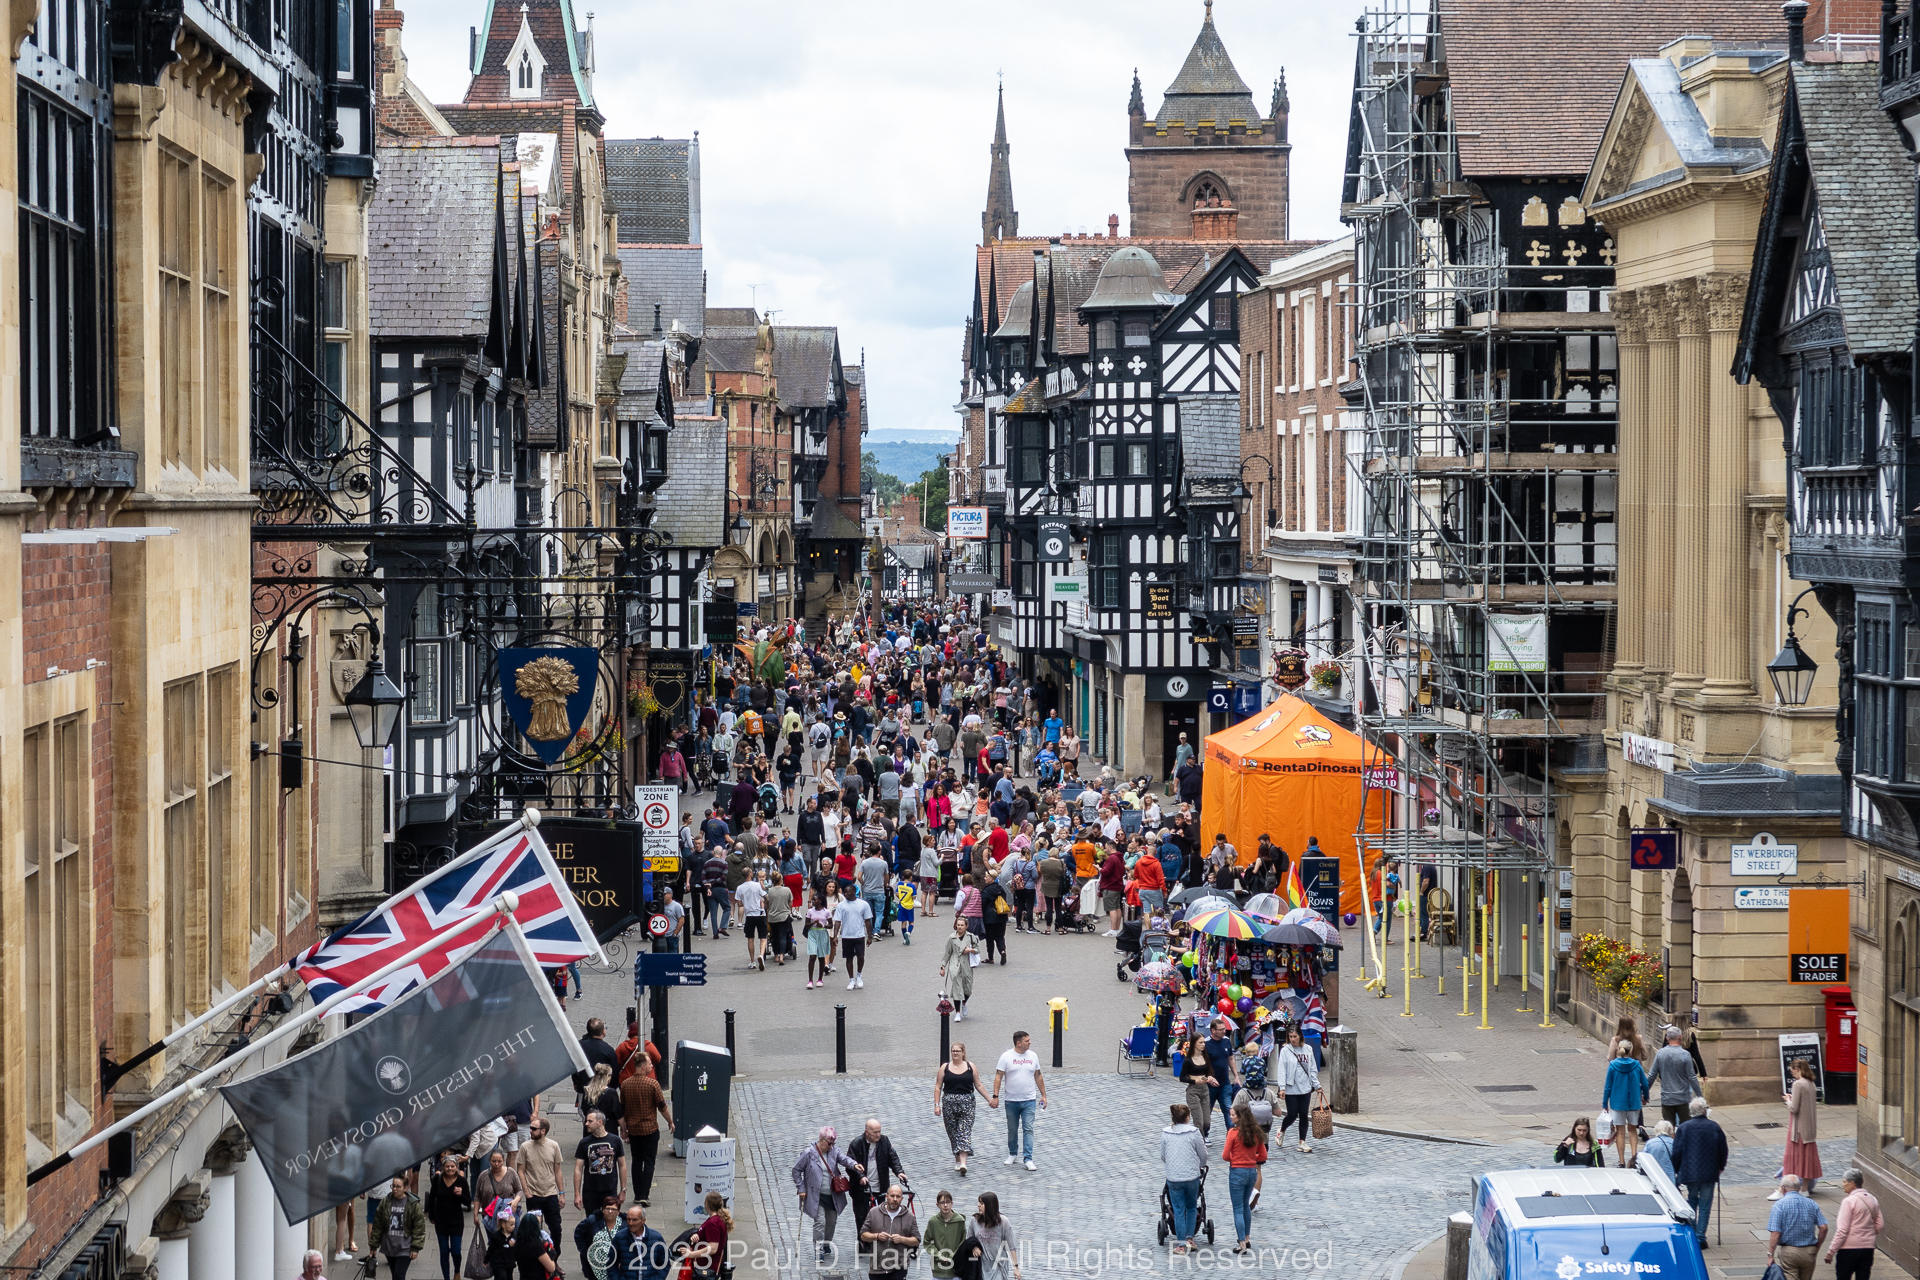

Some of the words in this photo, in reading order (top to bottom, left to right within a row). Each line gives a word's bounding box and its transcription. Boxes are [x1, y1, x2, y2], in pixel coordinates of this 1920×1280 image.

[952, 511, 982, 521] PICTURA
[1041, 522, 1067, 530] FATFACE
[1634, 738, 1658, 768] NatWest
[547, 843, 574, 859] HE
[1734, 850, 1745, 858] ST.
[1747, 850, 1795, 858] WERBURGH
[1747, 862, 1781, 870] STREET
[901, 891, 908, 901] 7
[1799, 956, 1838, 969] SOLE
[1585, 1261, 1631, 1276] Safety
[1634, 1261, 1661, 1273] Bus
